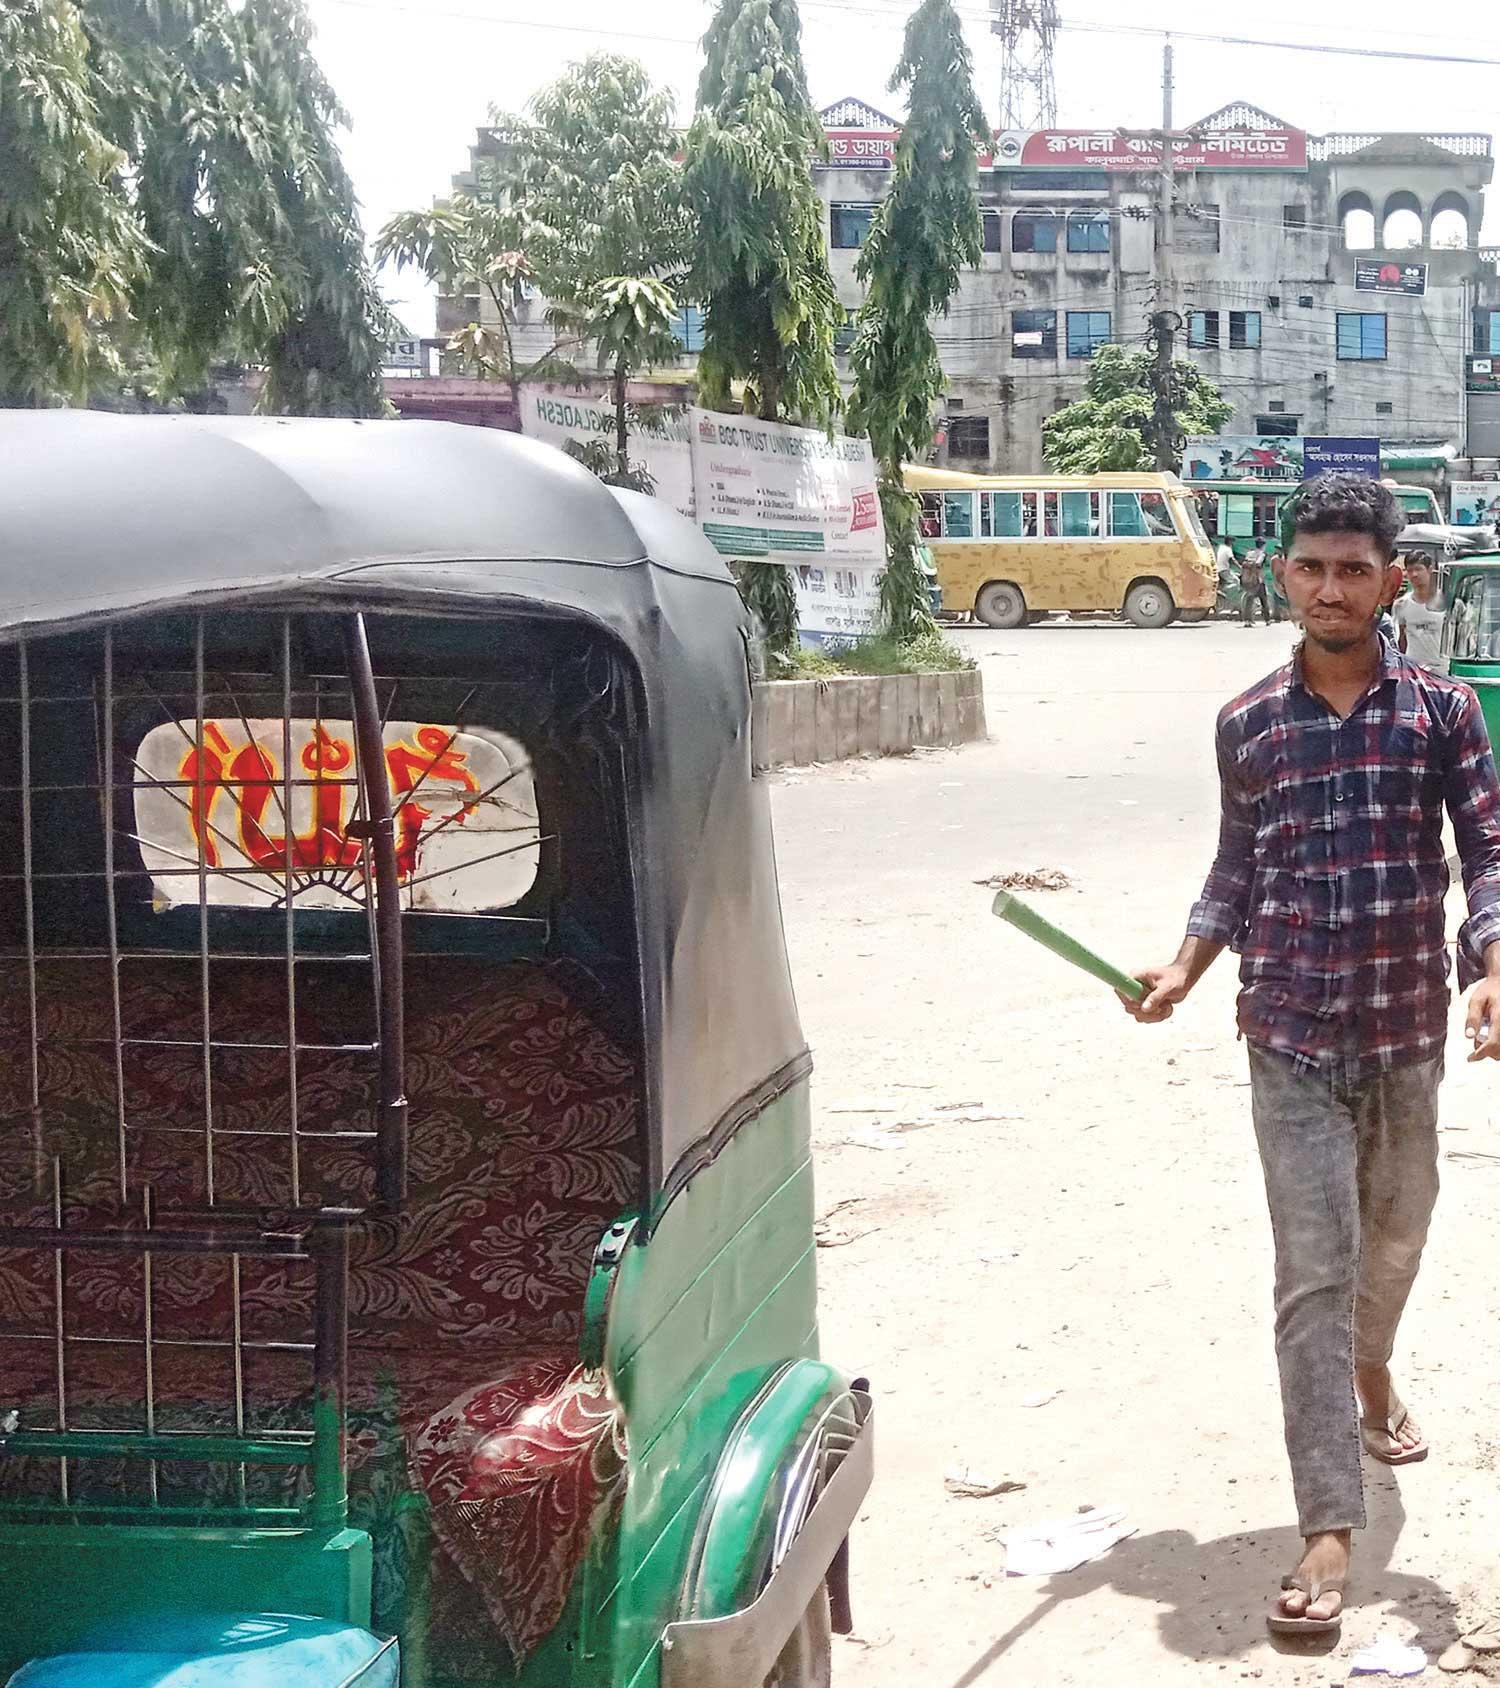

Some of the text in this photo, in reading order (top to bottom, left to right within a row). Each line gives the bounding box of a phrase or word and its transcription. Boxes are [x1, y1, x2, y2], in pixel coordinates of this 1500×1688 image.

[1199, 132, 1289, 153] লিমিটেড
[719, 425, 739, 445] BGC
[739, 428, 769, 452] TRUST
